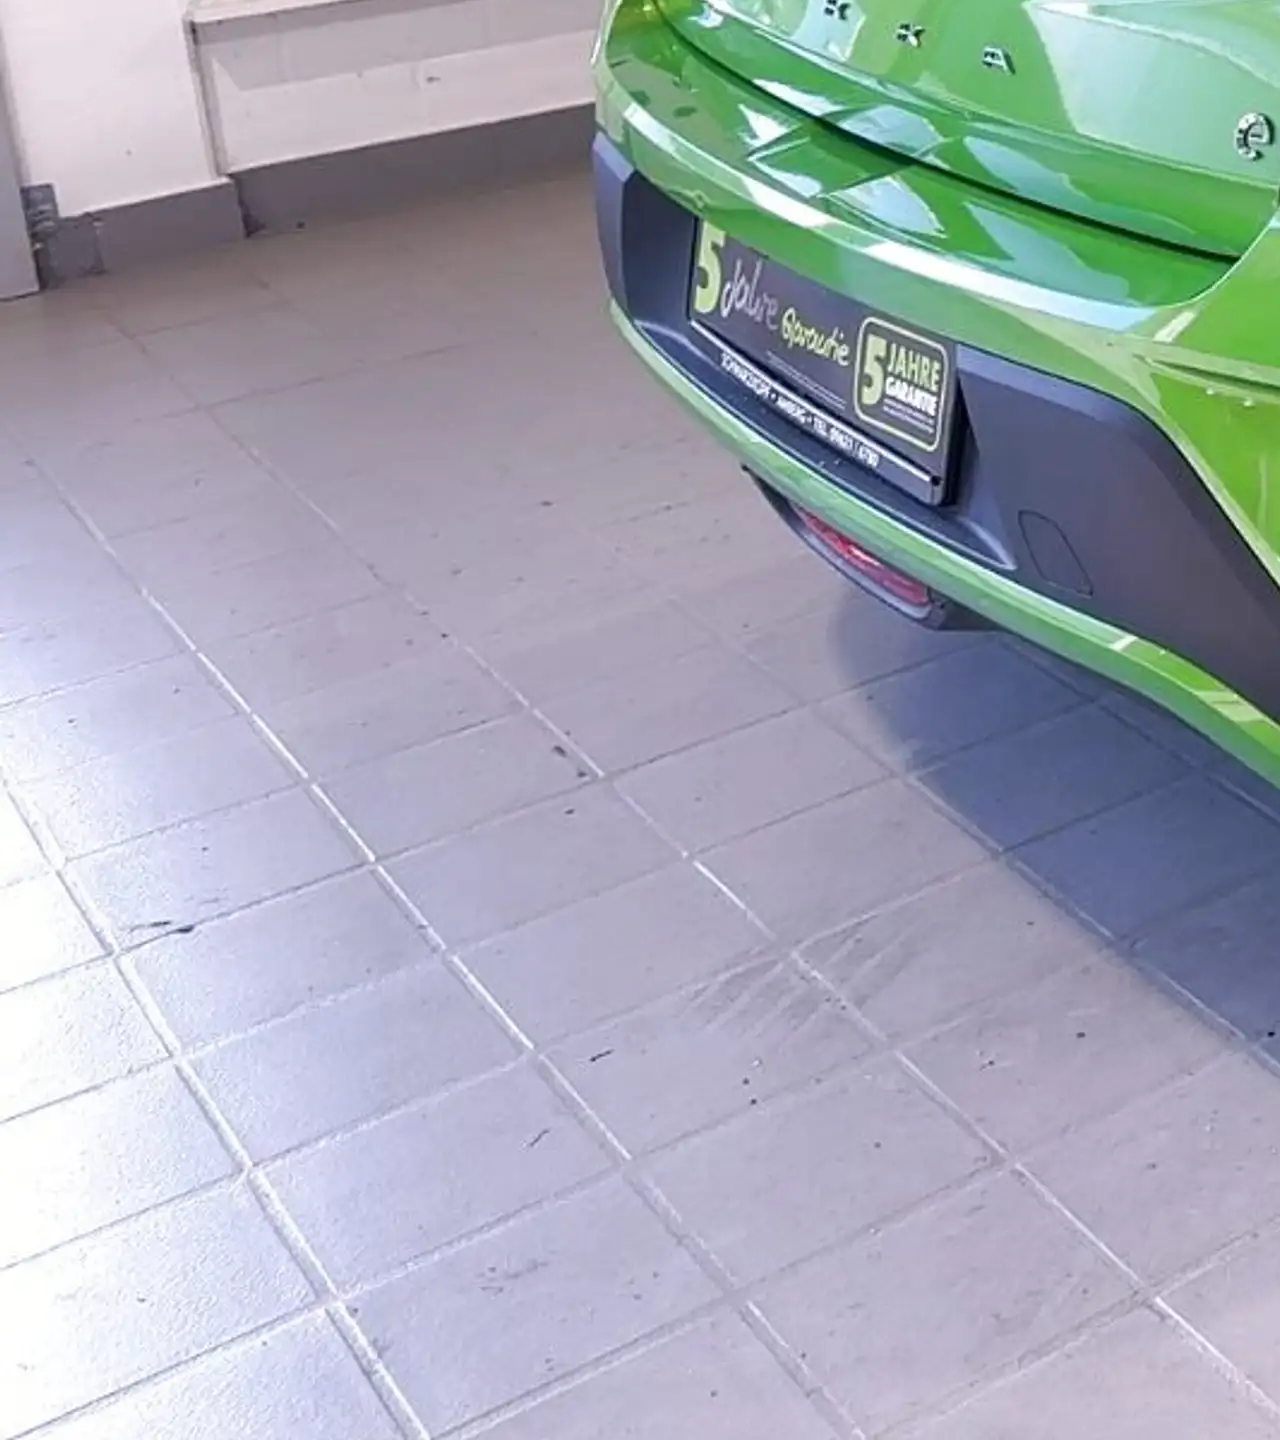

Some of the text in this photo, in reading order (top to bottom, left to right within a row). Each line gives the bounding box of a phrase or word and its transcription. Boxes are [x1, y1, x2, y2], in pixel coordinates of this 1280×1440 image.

[694, 221, 725, 314] 5
[860, 333, 888, 406] 5
[888, 342, 941, 391] JAHRE
